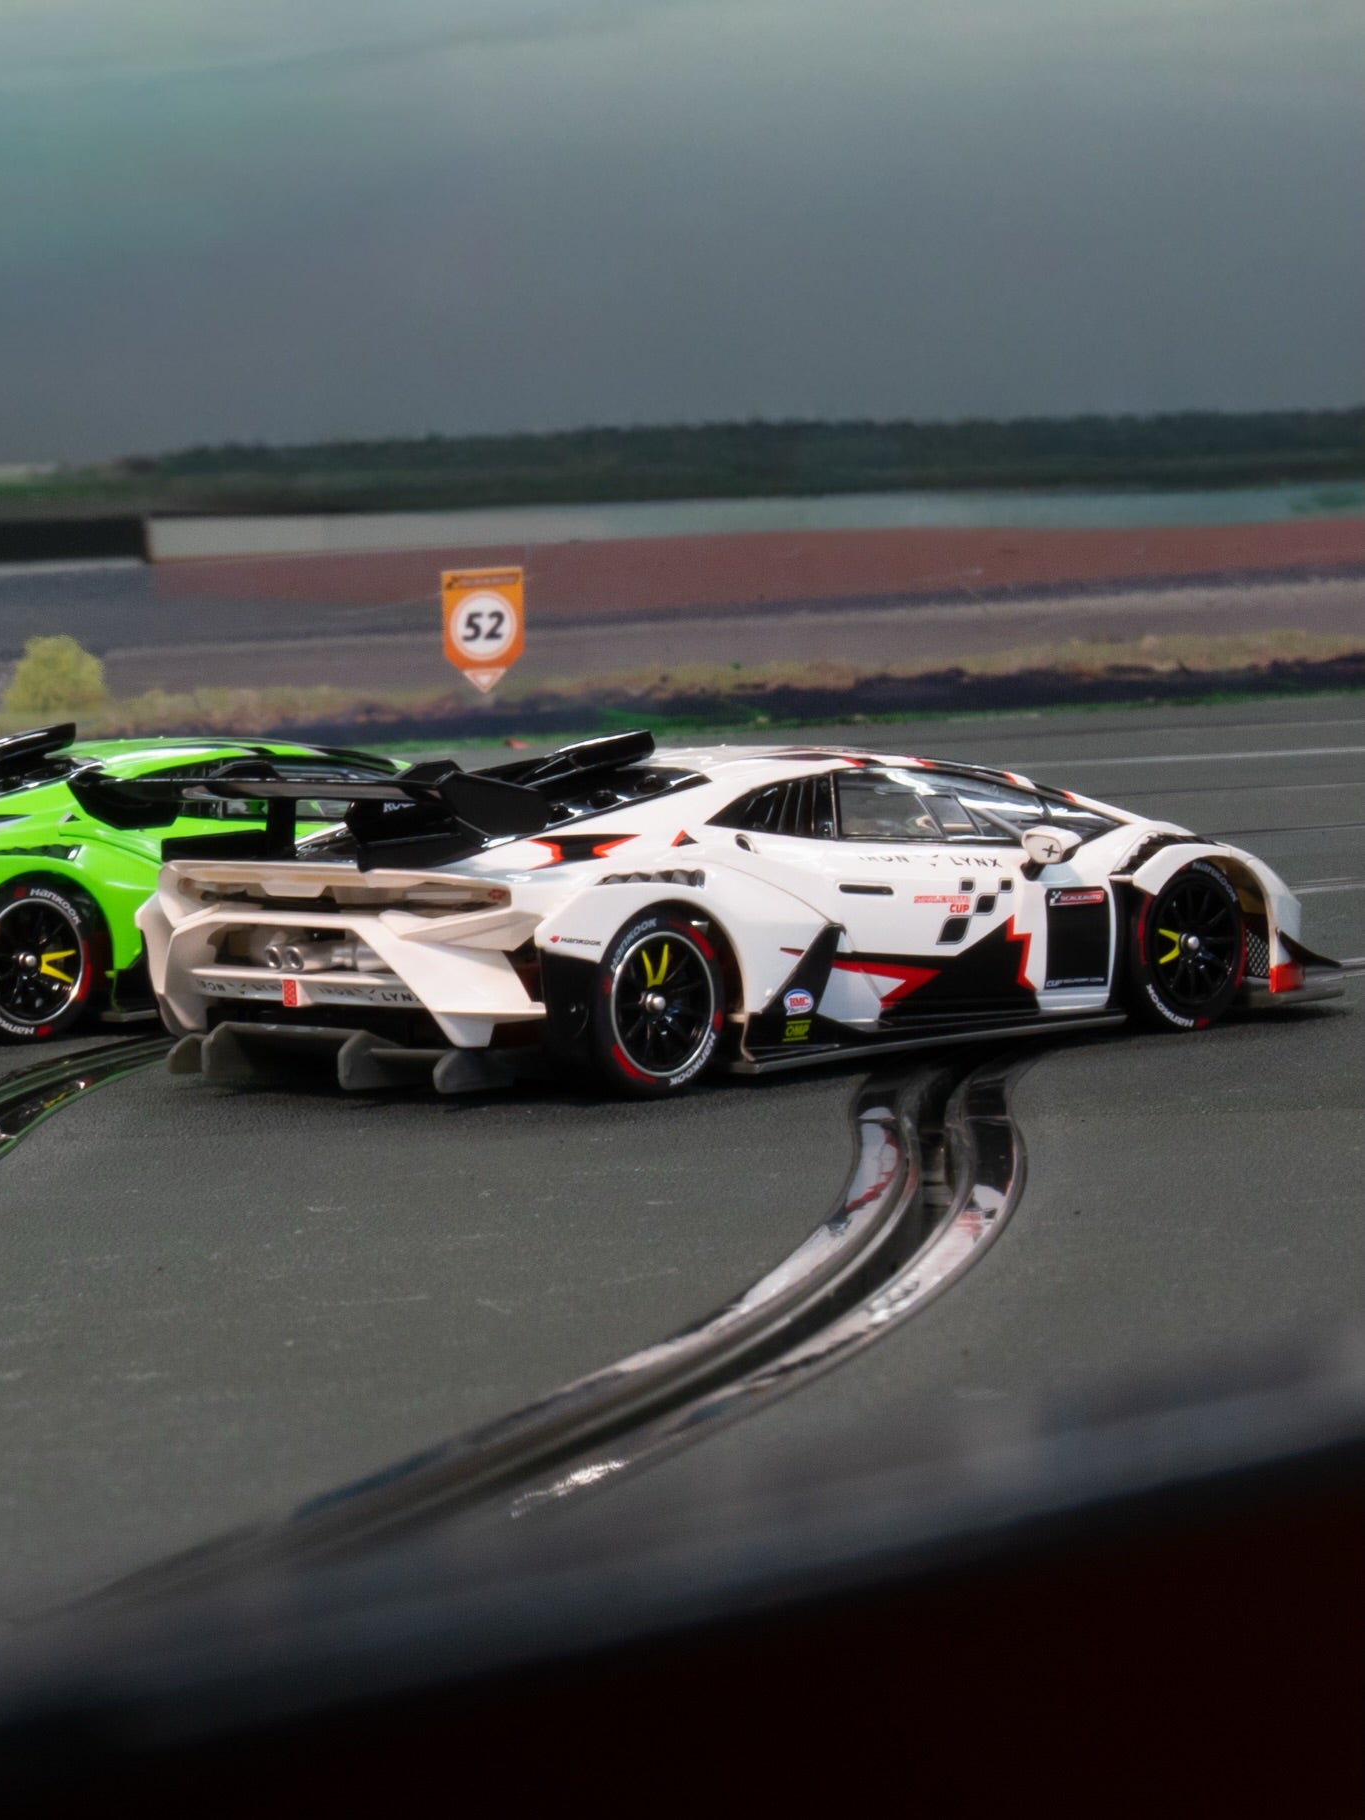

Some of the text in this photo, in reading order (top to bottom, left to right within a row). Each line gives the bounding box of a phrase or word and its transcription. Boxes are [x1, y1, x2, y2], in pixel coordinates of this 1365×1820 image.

[462, 610, 505, 642] 52
[948, 854, 1003, 869] LYNX
[949, 903, 970, 914] CUP
